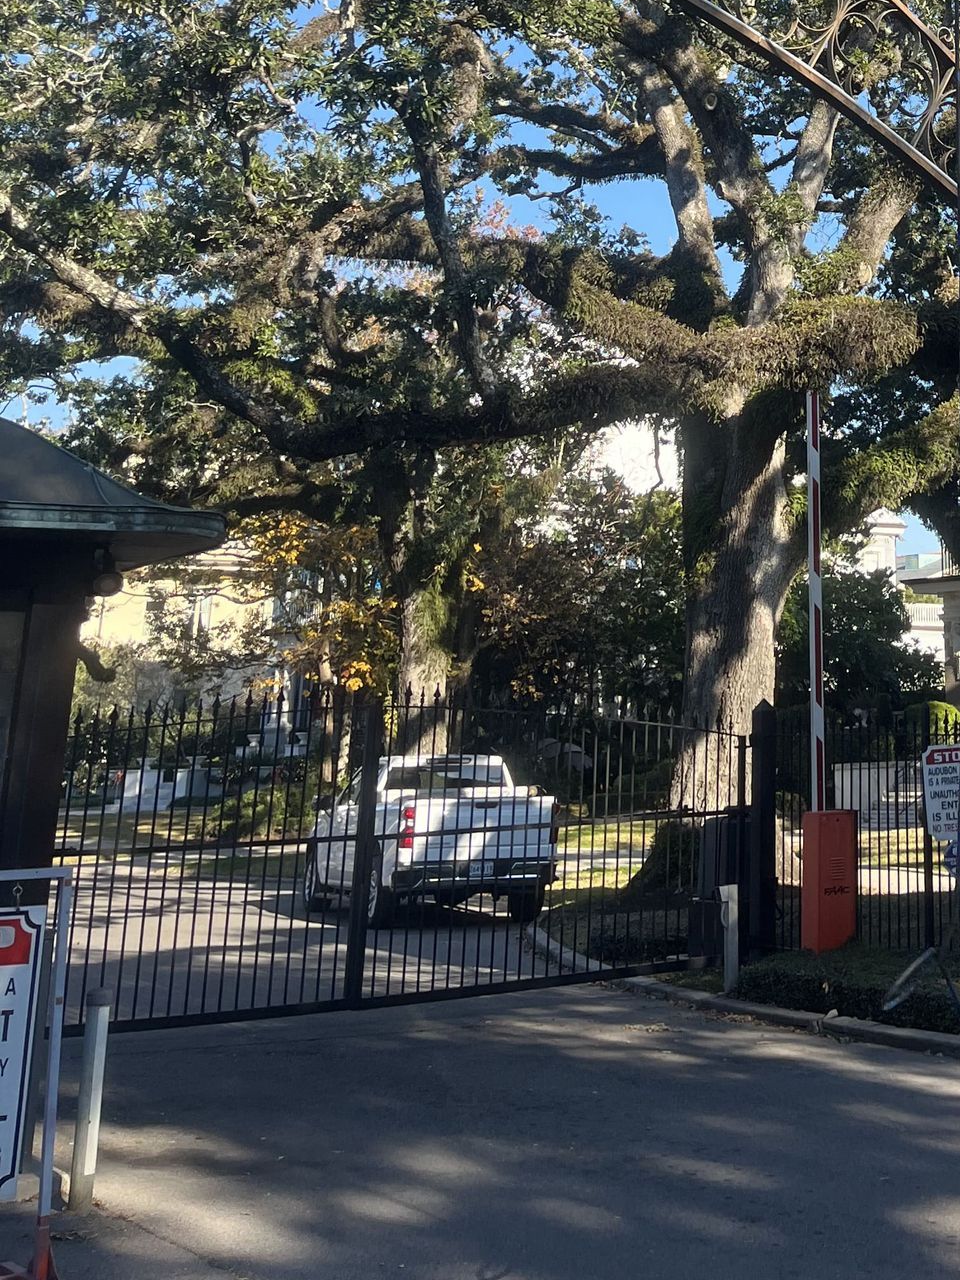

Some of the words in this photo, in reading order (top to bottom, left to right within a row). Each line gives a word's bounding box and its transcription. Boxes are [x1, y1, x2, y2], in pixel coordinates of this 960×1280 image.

[928, 766, 958, 777] AUDUBON
[932, 812, 941, 822] IS
[932, 824, 942, 833] NO
